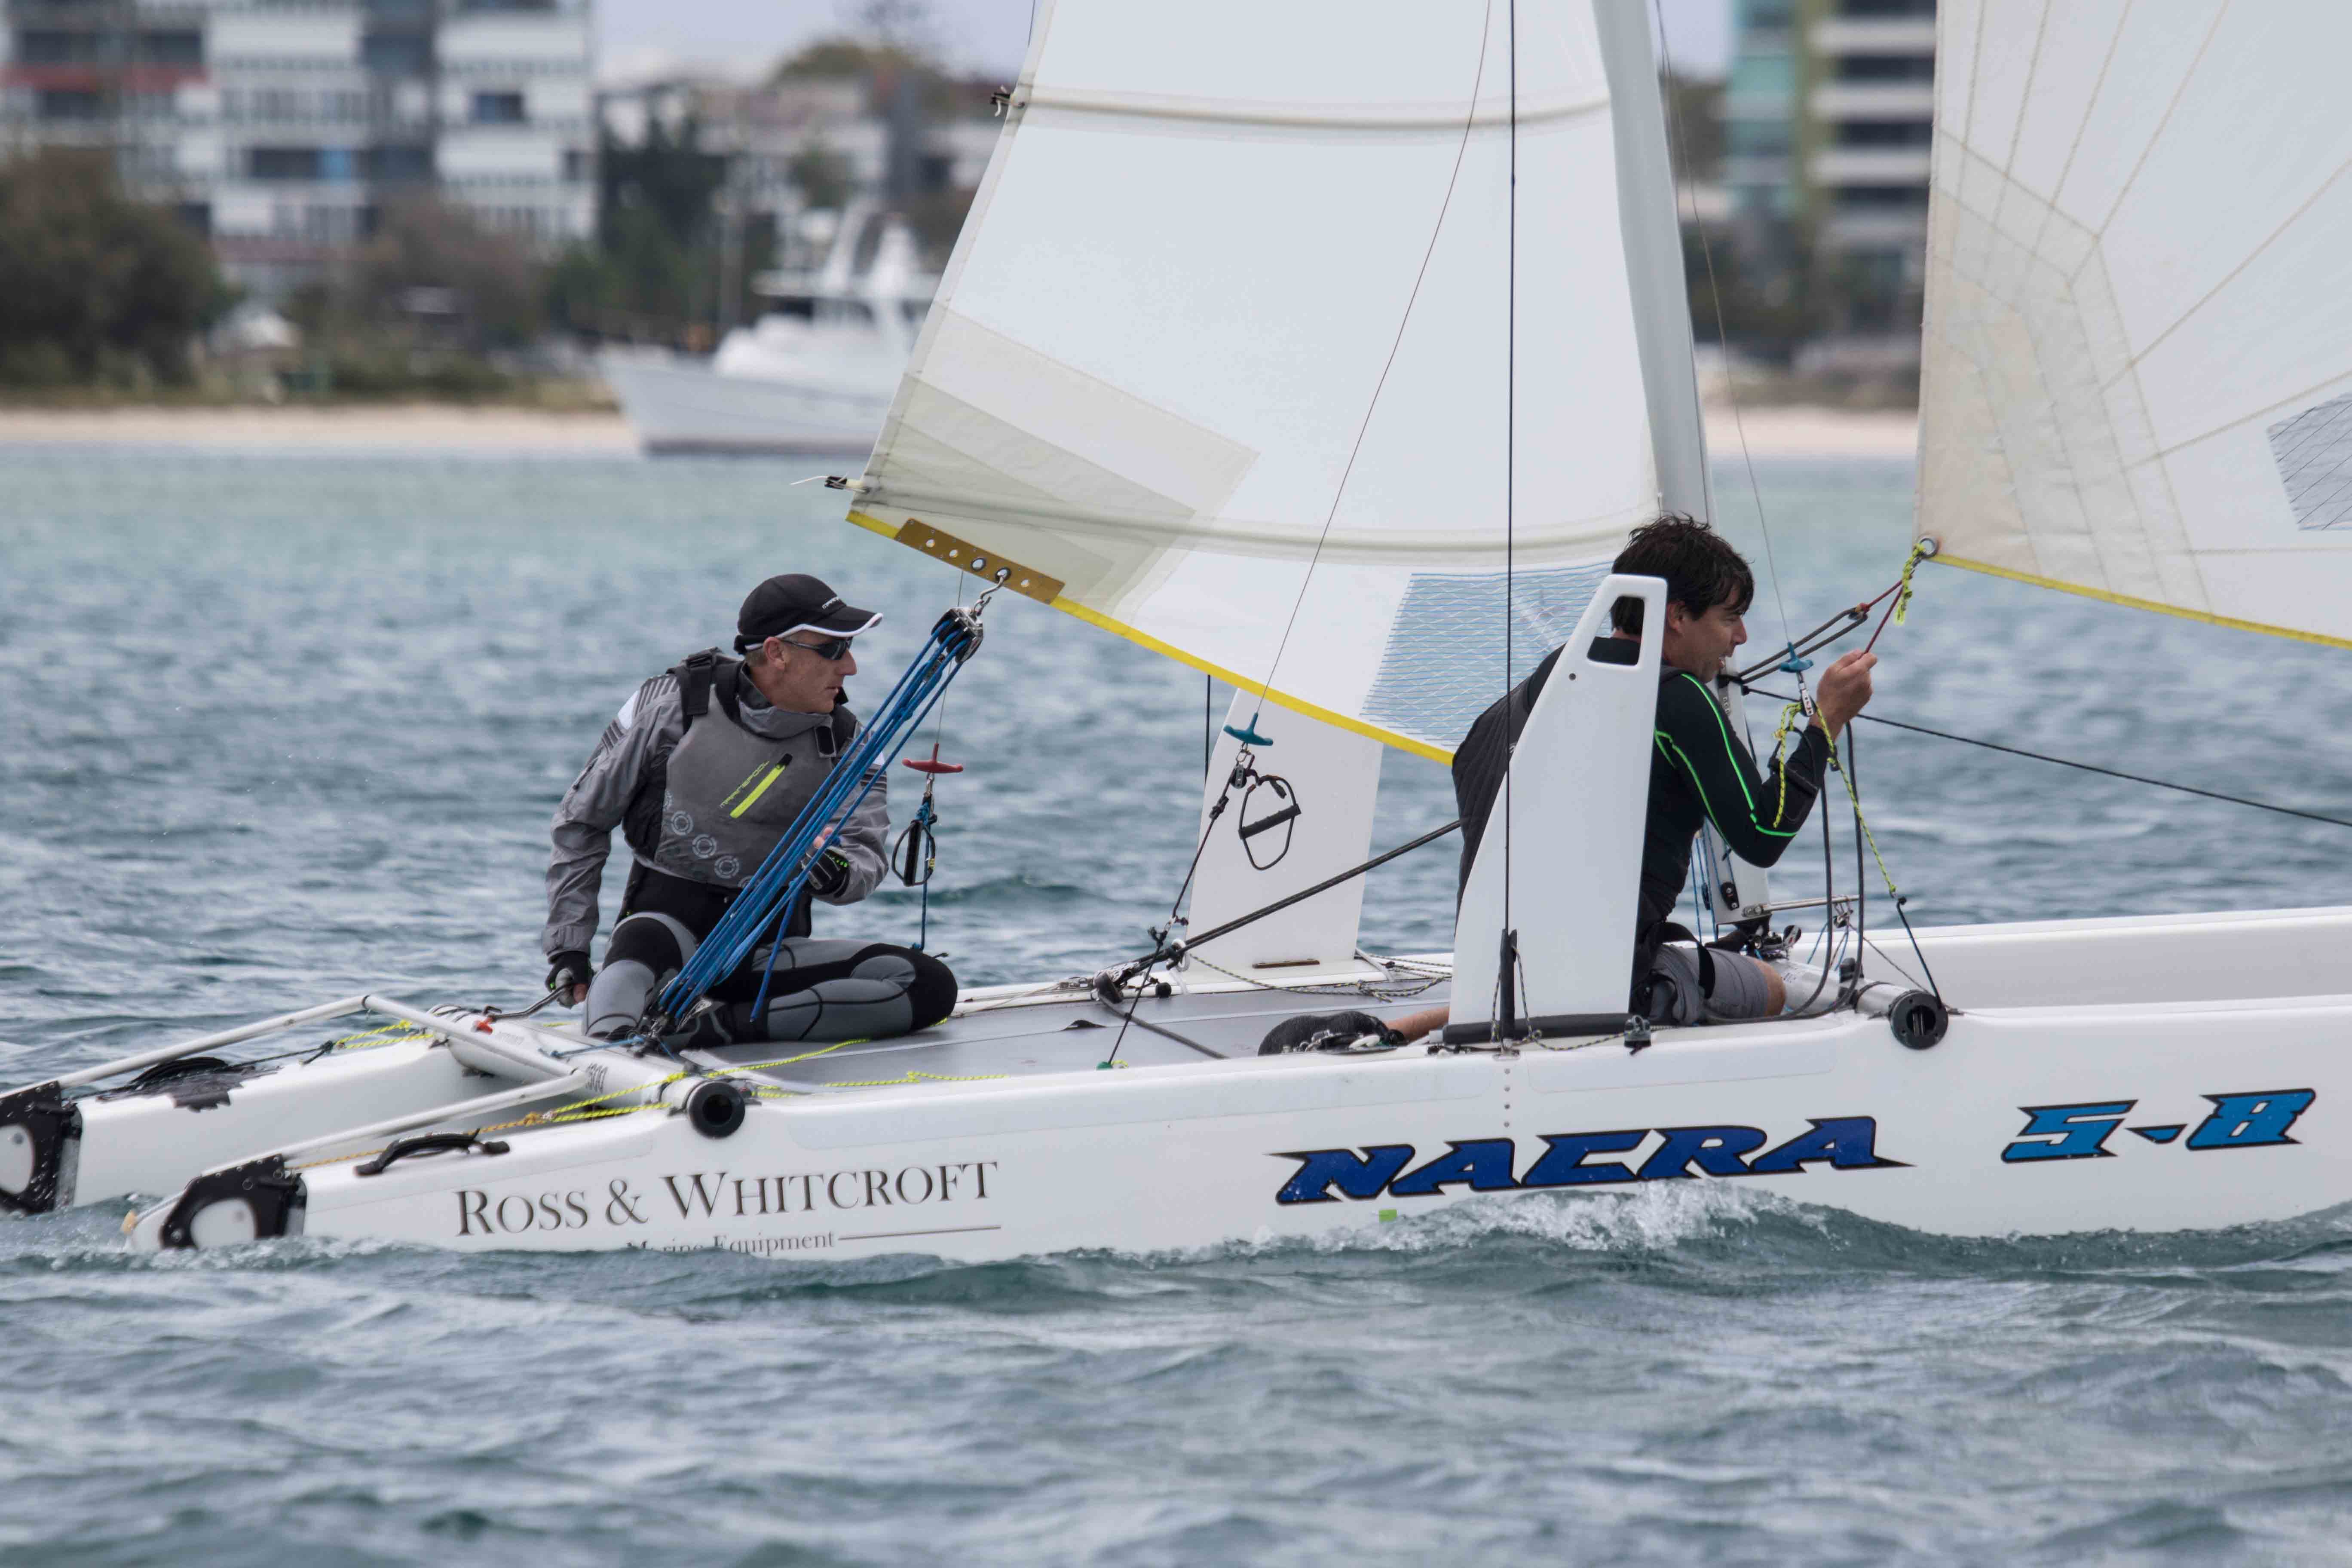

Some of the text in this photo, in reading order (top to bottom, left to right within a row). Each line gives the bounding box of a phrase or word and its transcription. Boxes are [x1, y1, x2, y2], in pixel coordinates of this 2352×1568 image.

[1264, 1088, 2316, 1205] NACRA 5-8
[454, 1162, 998, 1236] ROSS & WHITCROFT
[713, 1231, 835, 1256] Equipment
